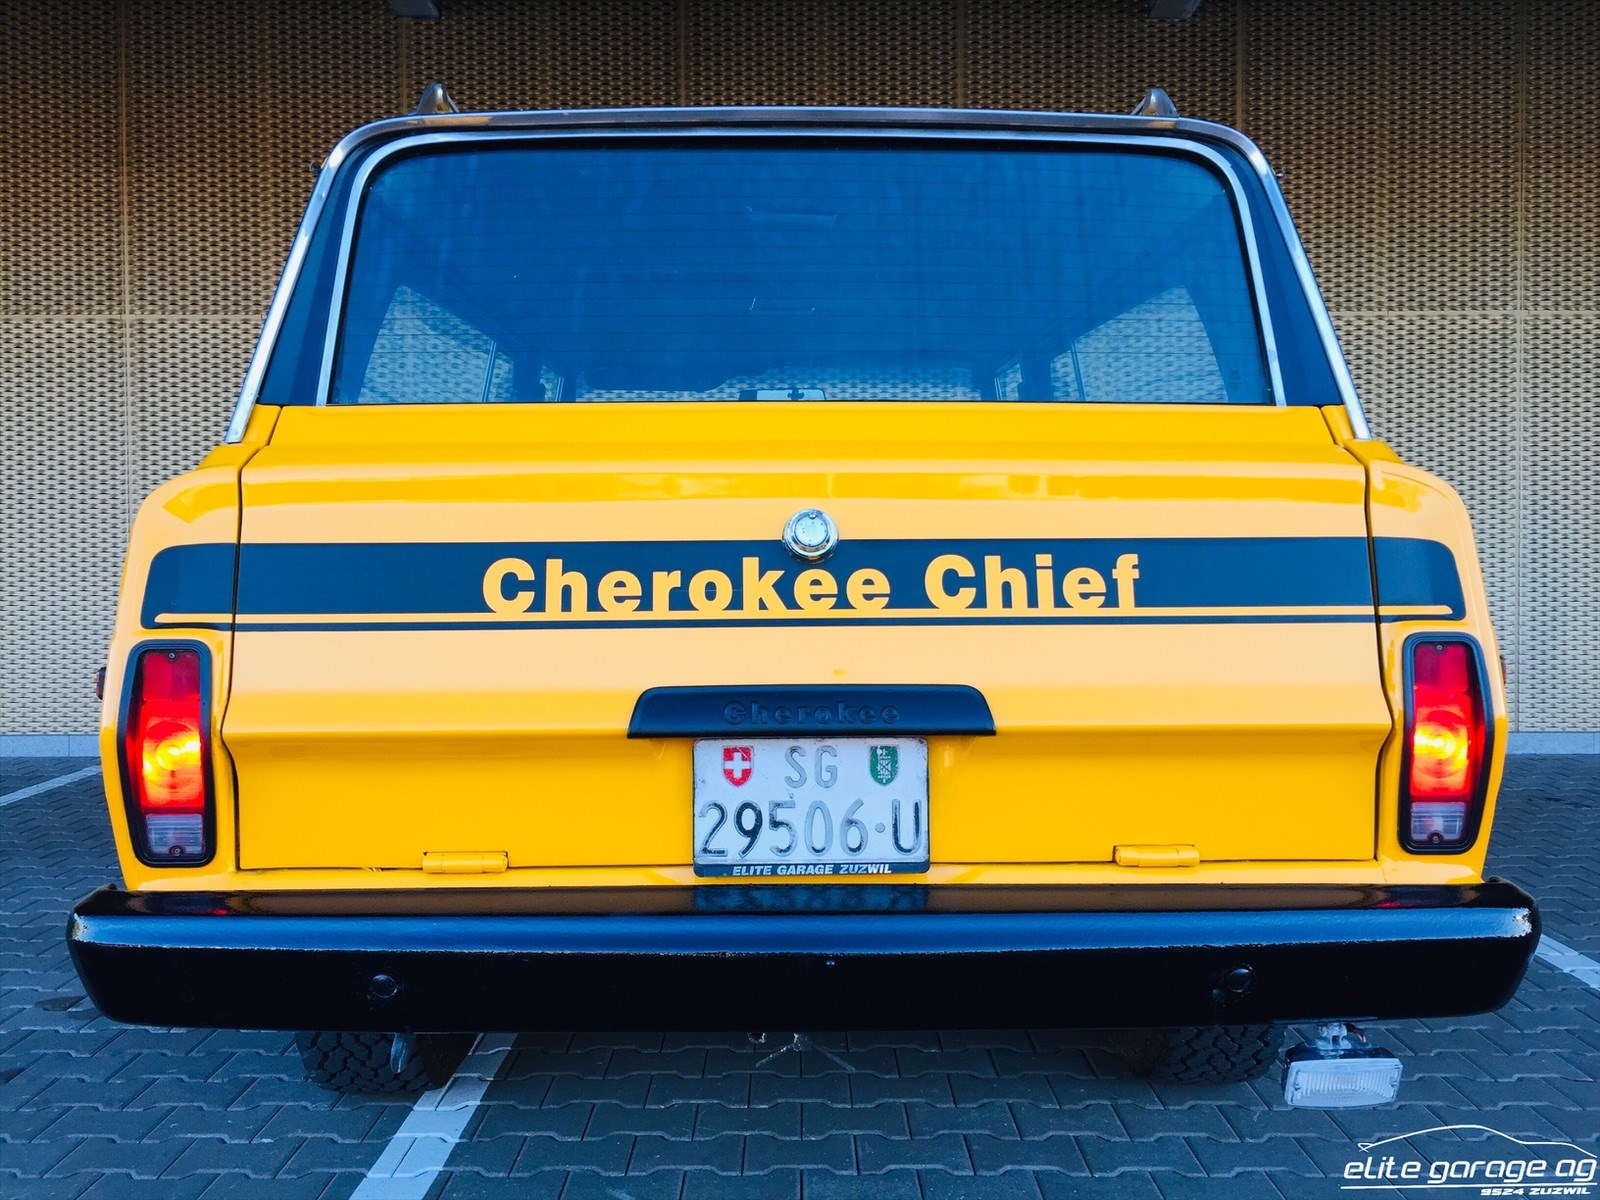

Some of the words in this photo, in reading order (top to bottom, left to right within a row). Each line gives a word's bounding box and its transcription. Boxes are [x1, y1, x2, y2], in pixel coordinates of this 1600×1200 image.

[482, 556, 891, 613] Cherokee
[924, 553, 1140, 610] Chief
[724, 700, 900, 725] Cherokee
[784, 745, 838, 789] SG
[732, 866, 773, 877] ELITE
[776, 865, 833, 876] GARAGE
[839, 864, 892, 875] ZUZWIL
